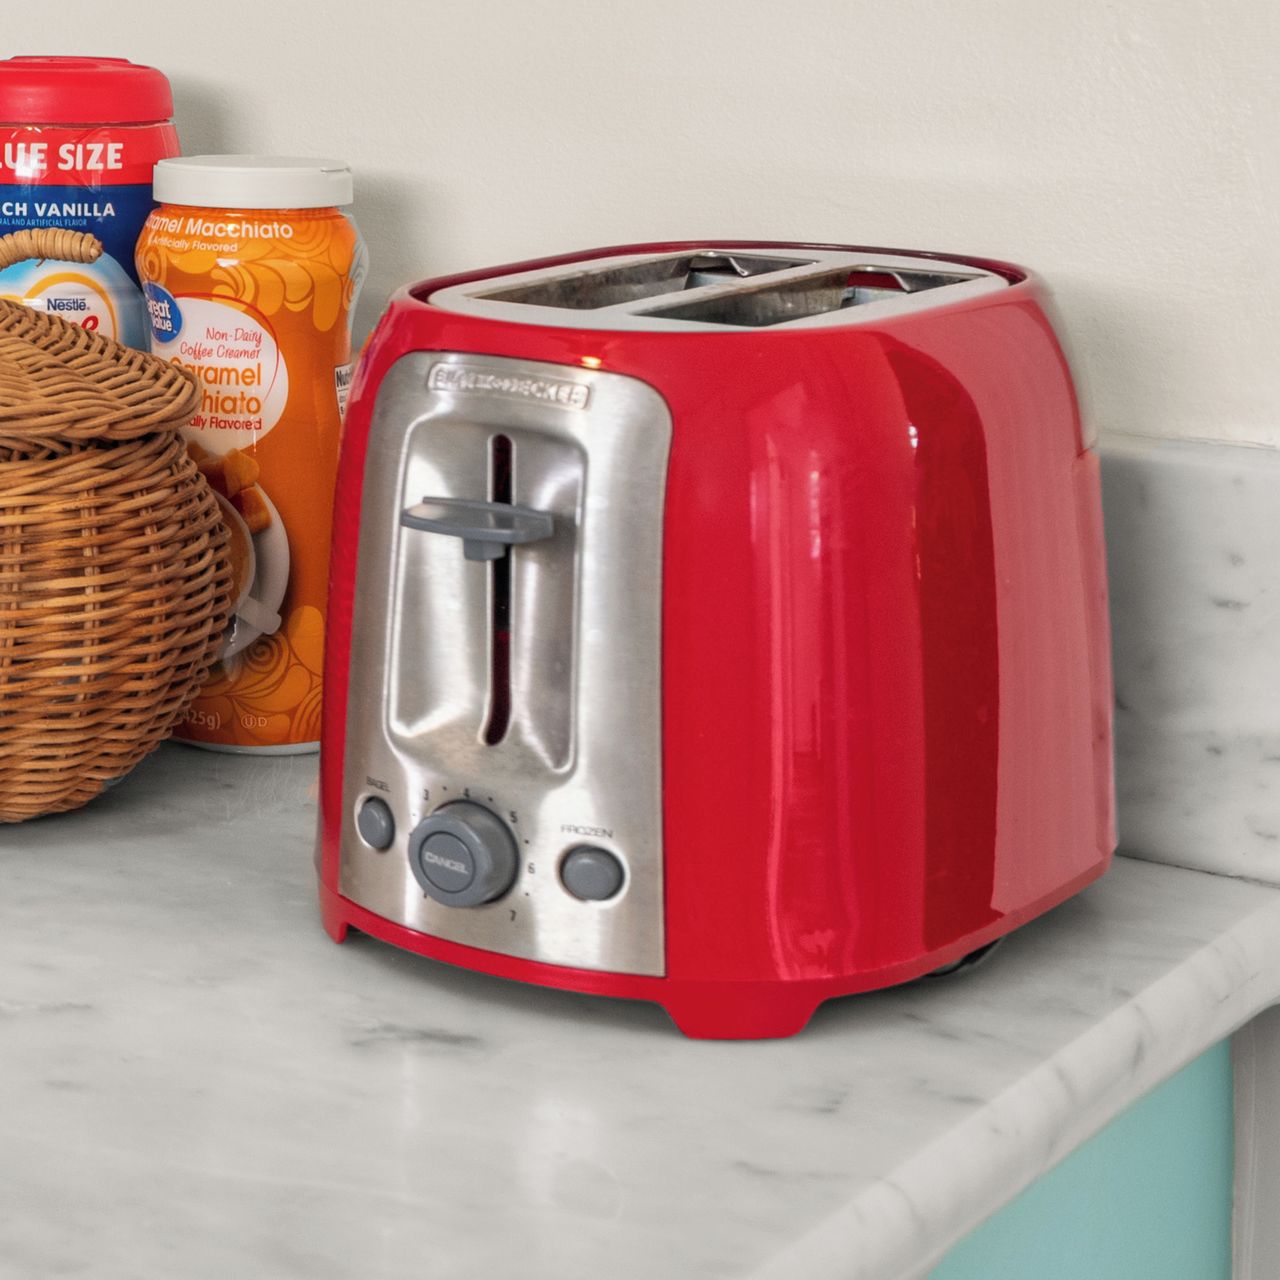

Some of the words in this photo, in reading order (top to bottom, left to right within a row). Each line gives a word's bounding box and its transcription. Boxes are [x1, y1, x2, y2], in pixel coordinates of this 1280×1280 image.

[57, 142, 123, 170] SIZE
[34, 202, 115, 217] VANILLA
[11, 218, 25, 226] AND
[26, 219, 63, 227] ARTIFICIAL
[185, 218, 293, 238] Macchiato
[192, 241, 238, 252] Flavored
[180, 341, 214, 360] Coffee
[216, 344, 261, 360] Creamer
[201, 389, 261, 414] hiato
[209, 416, 262, 430] Flavored
[510, 810, 518, 823] 5
[560, 825, 614, 839] FROZEN
[528, 862, 536, 874] 6
[510, 909, 517, 922] 7
